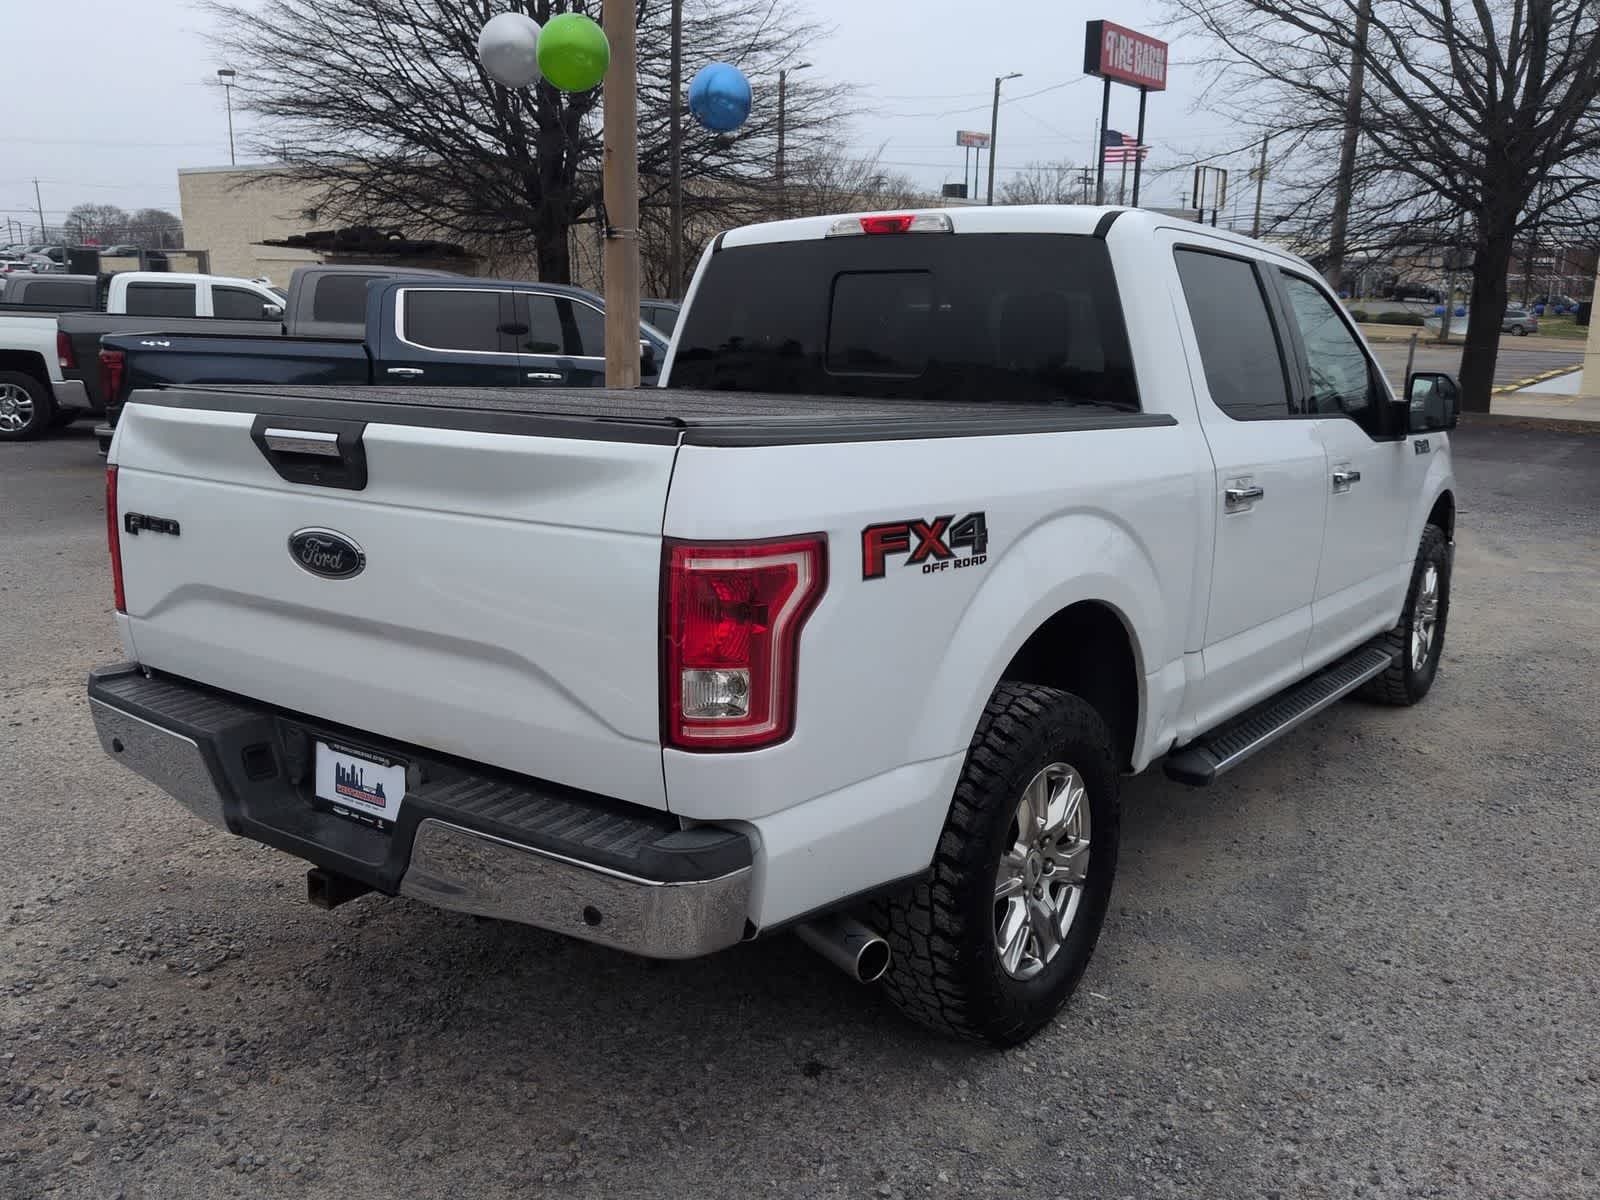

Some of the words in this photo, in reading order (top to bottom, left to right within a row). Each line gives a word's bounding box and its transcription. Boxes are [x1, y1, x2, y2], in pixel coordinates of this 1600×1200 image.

[1106, 31, 1133, 72] TIRE
[301, 537, 344, 570] Ford
[861, 510, 988, 582] FX4
[922, 561, 950, 575] OFF
[953, 554, 988, 570] ROAD
